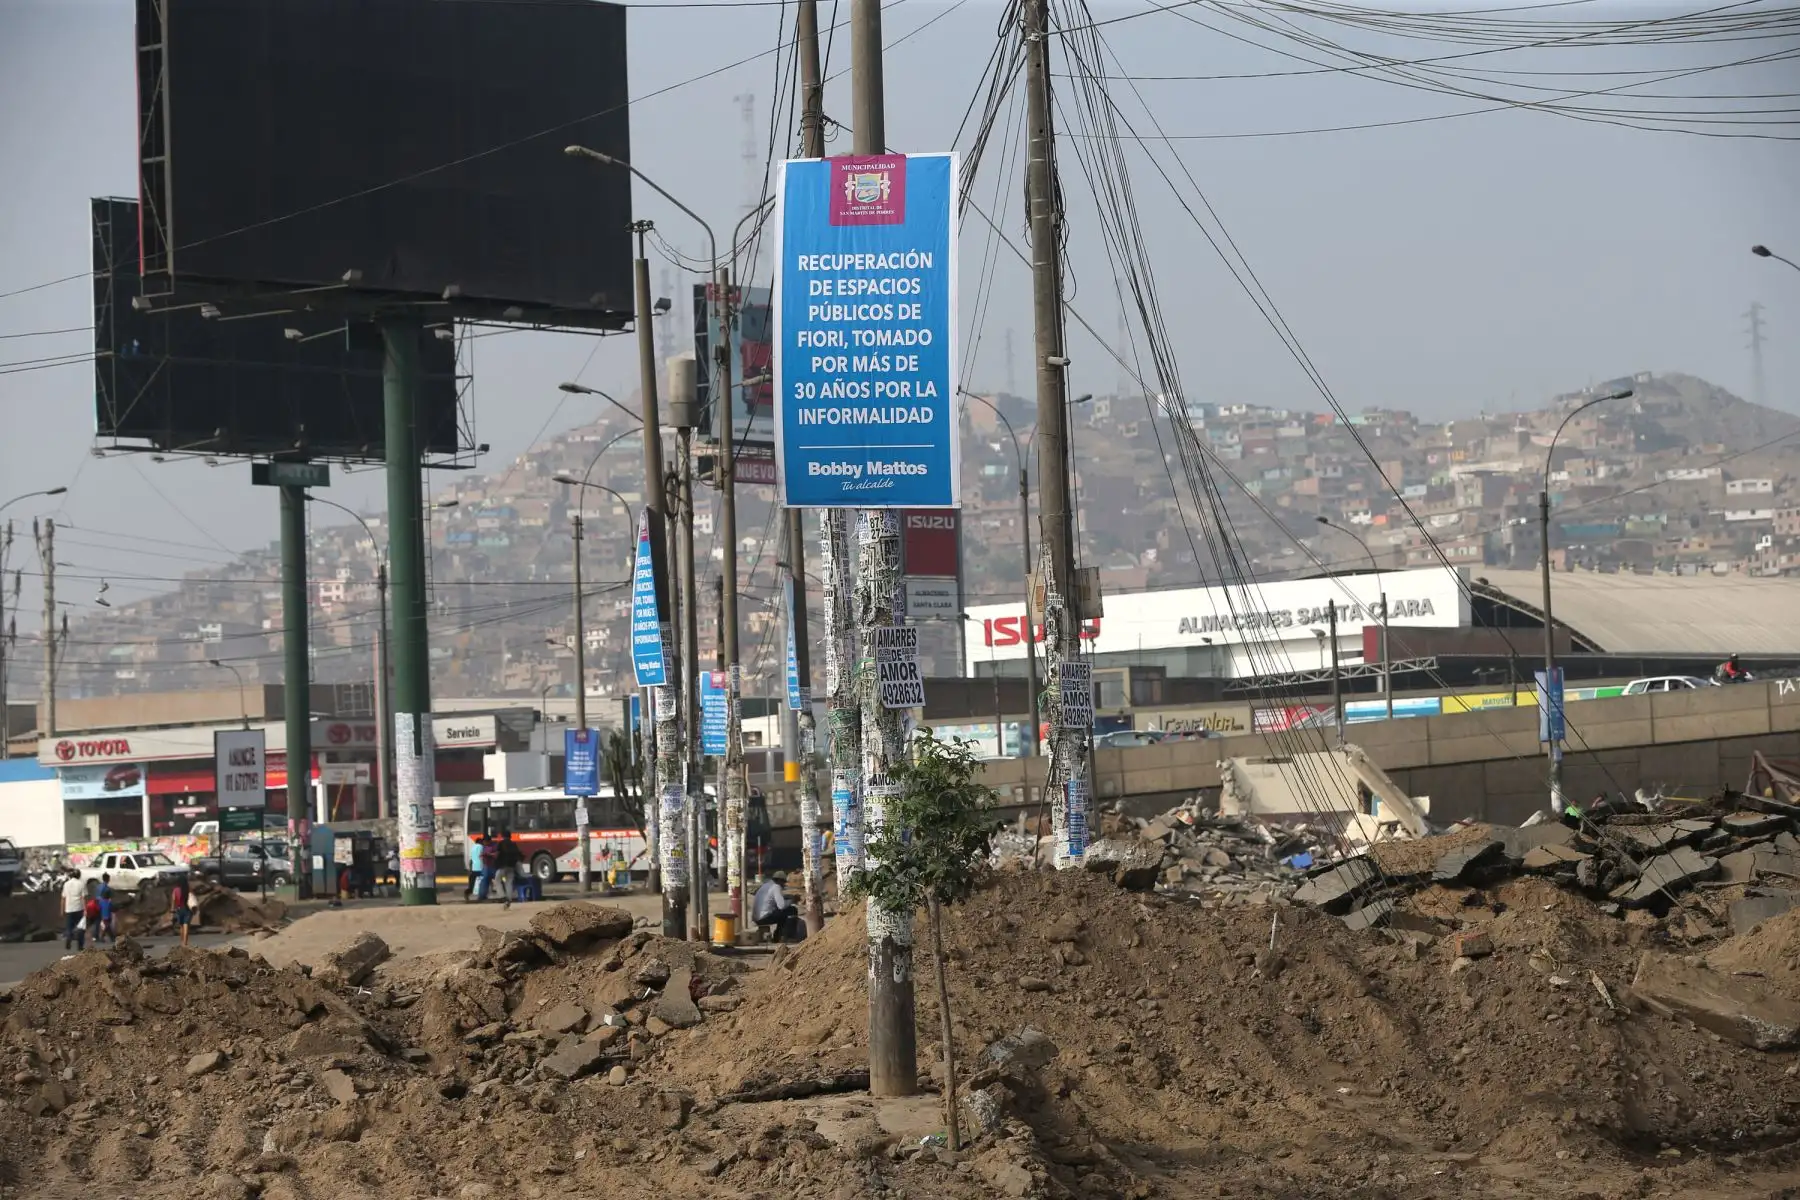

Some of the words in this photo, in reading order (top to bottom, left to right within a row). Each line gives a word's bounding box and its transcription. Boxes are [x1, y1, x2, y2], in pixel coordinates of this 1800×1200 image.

[841, 163, 896, 171] MUNICIPALIDAD
[798, 249, 933, 271] RECUPERACIÓN
[809, 279, 832, 296] DE
[837, 278, 921, 295] ESPACIOS
[809, 301, 894, 321] PÚBLICOS
[898, 303, 922, 320] DE
[797, 330, 848, 349] FIORI,
[852, 329, 933, 346] TOMADO
[811, 356, 848, 373] POR
[853, 352, 890, 372] MÁS
[895, 355, 919, 372] DE
[794, 382, 816, 400] 30
[820, 378, 870, 399] AÑOS
[875, 381, 911, 398] POR
[915, 380, 937, 397] LA
[798, 406, 934, 425] INFORMALIDAD
[808, 462, 863, 479] Bobby
[867, 461, 928, 476] Mattos
[907, 515, 955, 529] ISUZU
[1178, 610, 1293, 635] ALMACENES
[1297, 604, 1365, 626] SANTA
[1367, 598, 1435, 620] CLARA
[877, 628, 917, 648] AMARRES
[891, 649, 902, 662] DE
[880, 661, 919, 681] AMOR
[1061, 663, 1091, 679] AMARRES
[882, 682, 923, 705] 4928632
[1072, 681, 1080, 691] DE
[1063, 691, 1091, 707] AMOR
[446, 726, 481, 740] Servicio
[76, 738, 132, 757] TOYOTA
